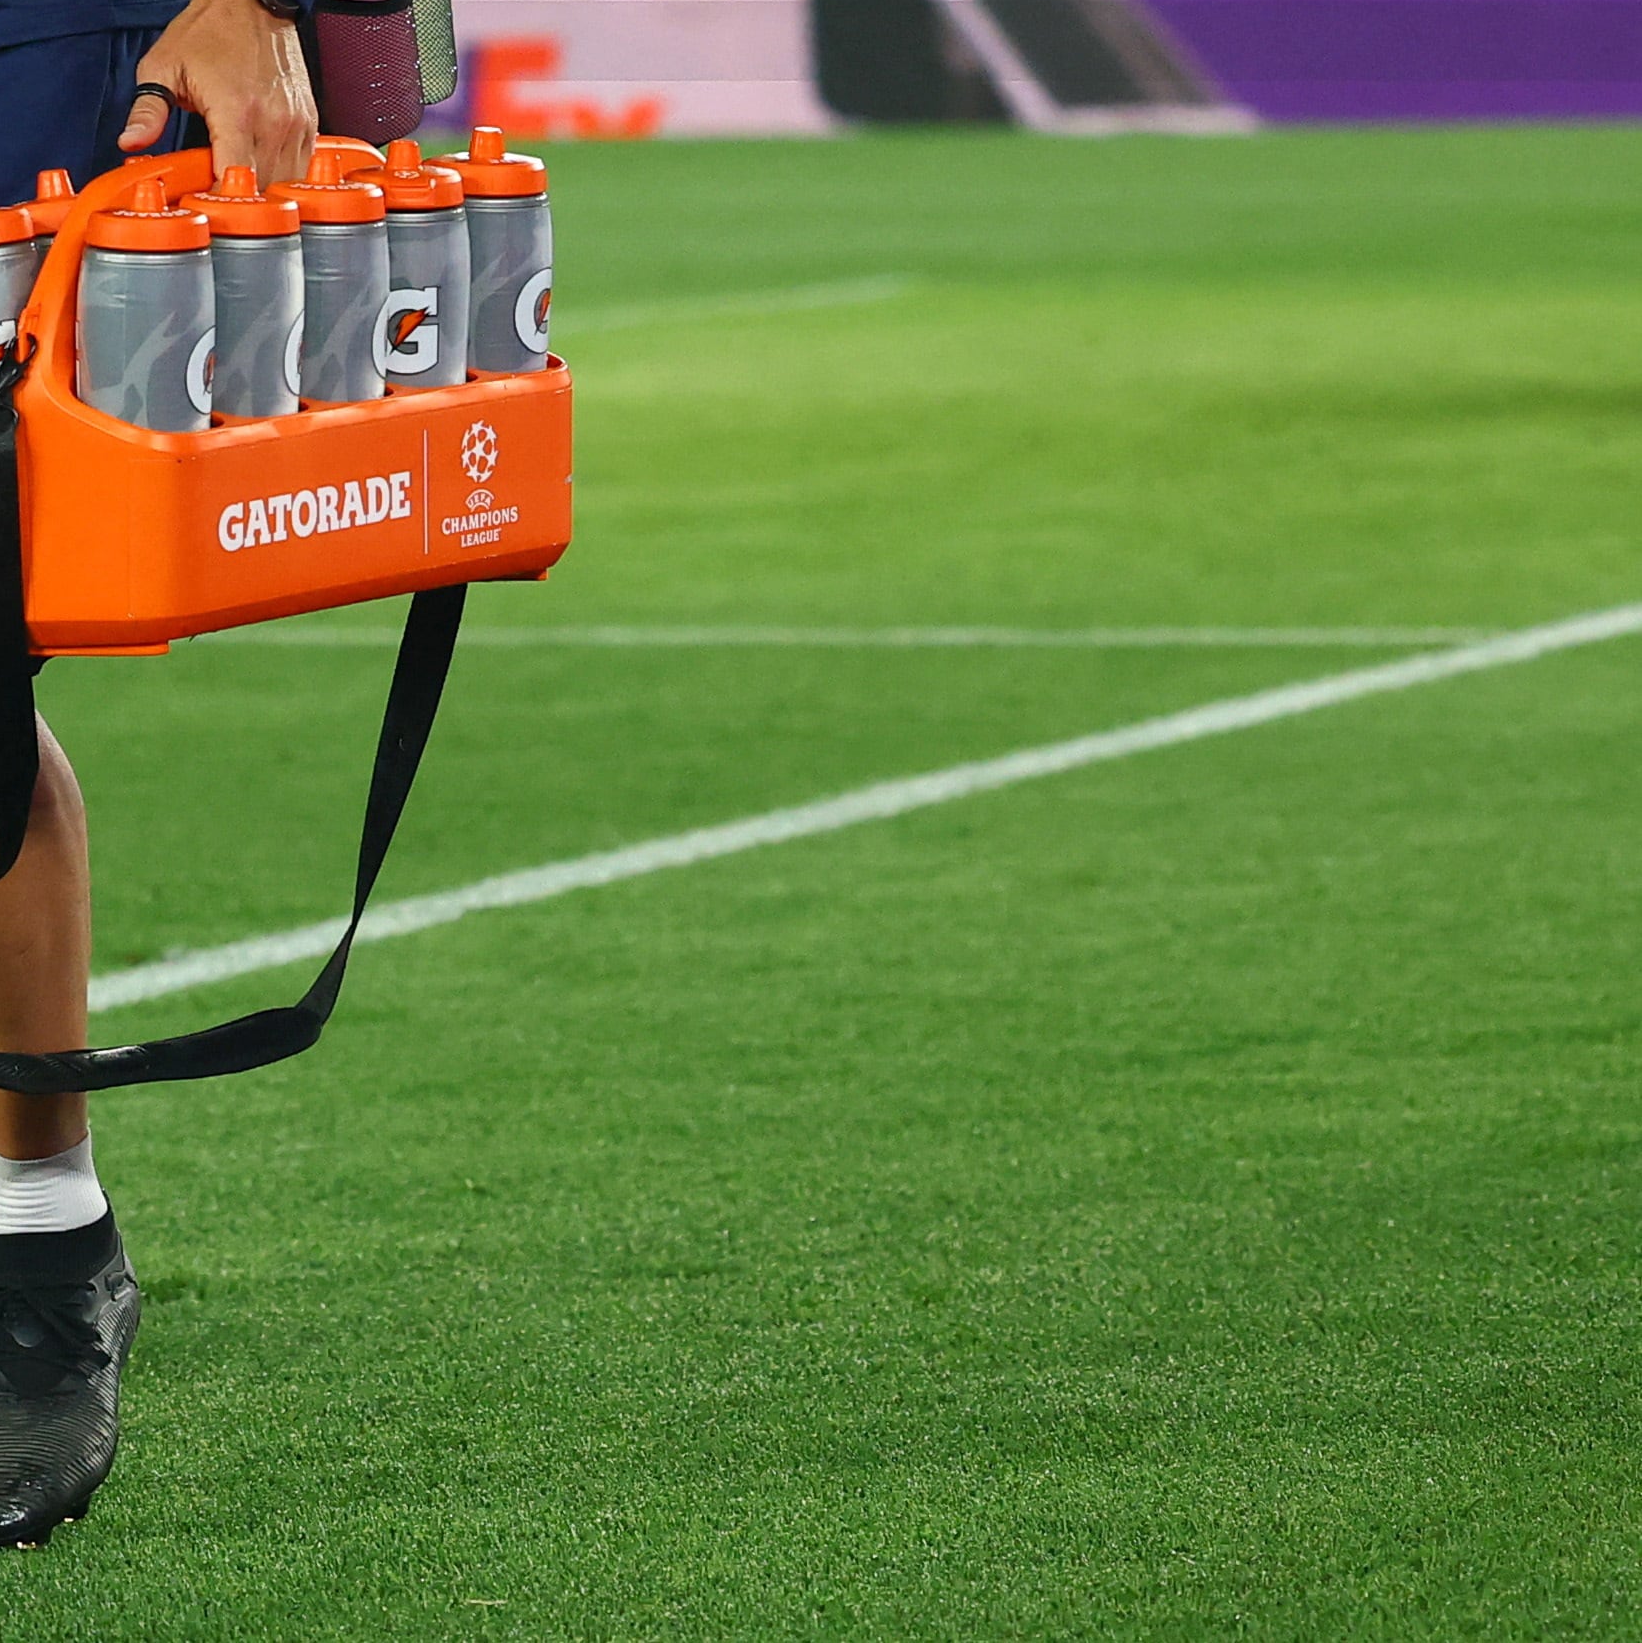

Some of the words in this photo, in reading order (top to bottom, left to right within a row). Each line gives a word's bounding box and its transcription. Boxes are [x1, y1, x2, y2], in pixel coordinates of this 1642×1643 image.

[376, 286, 440, 376] G
[218, 471, 411, 552] GATORADE
[467, 492, 492, 508] UEFA
[441, 506, 519, 535] CHAMPIONS
[460, 528, 500, 548] LEAGUE
